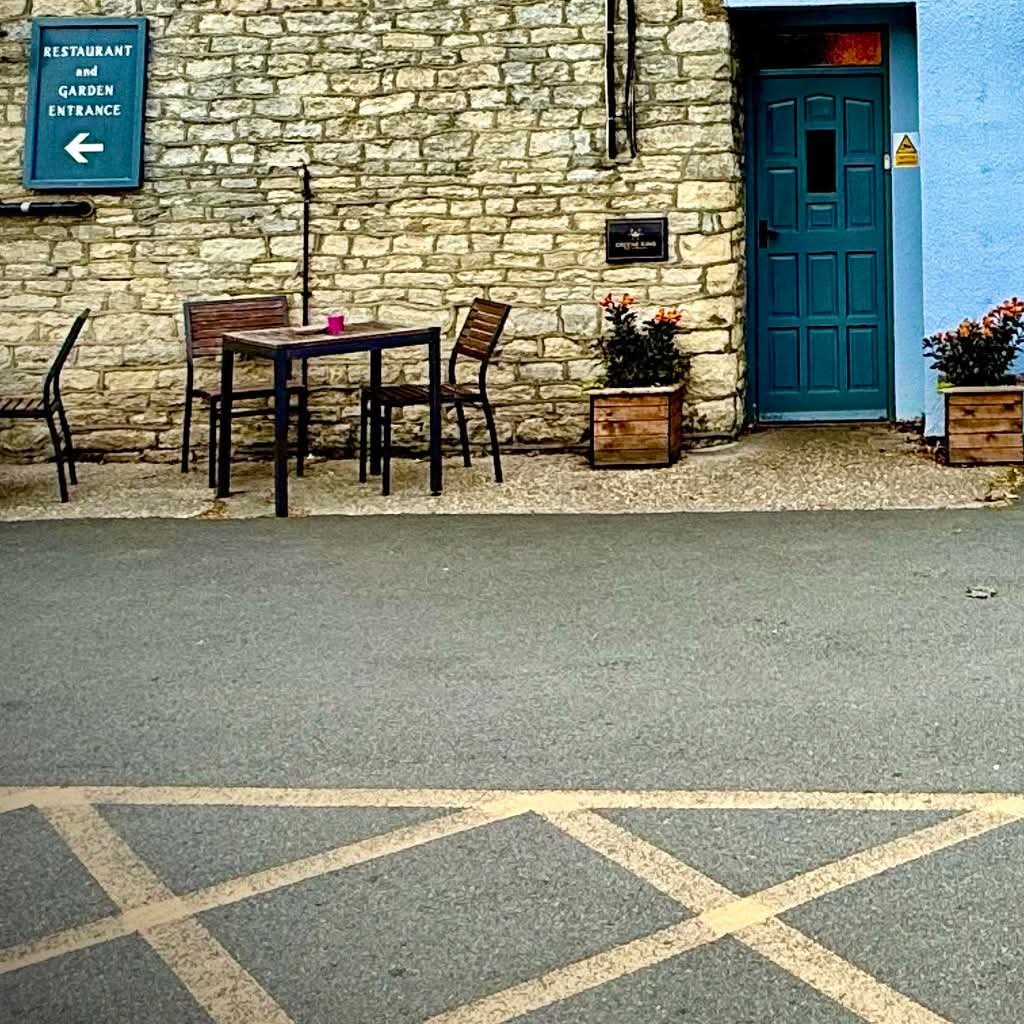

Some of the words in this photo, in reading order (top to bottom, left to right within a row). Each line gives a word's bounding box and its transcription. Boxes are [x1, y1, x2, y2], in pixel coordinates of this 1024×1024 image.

[43, 44, 133, 58] RESTAURANT
[75, 64, 99, 77] and
[58, 84, 115, 99] GARDEN
[48, 104, 122, 117] ENTRANCE
